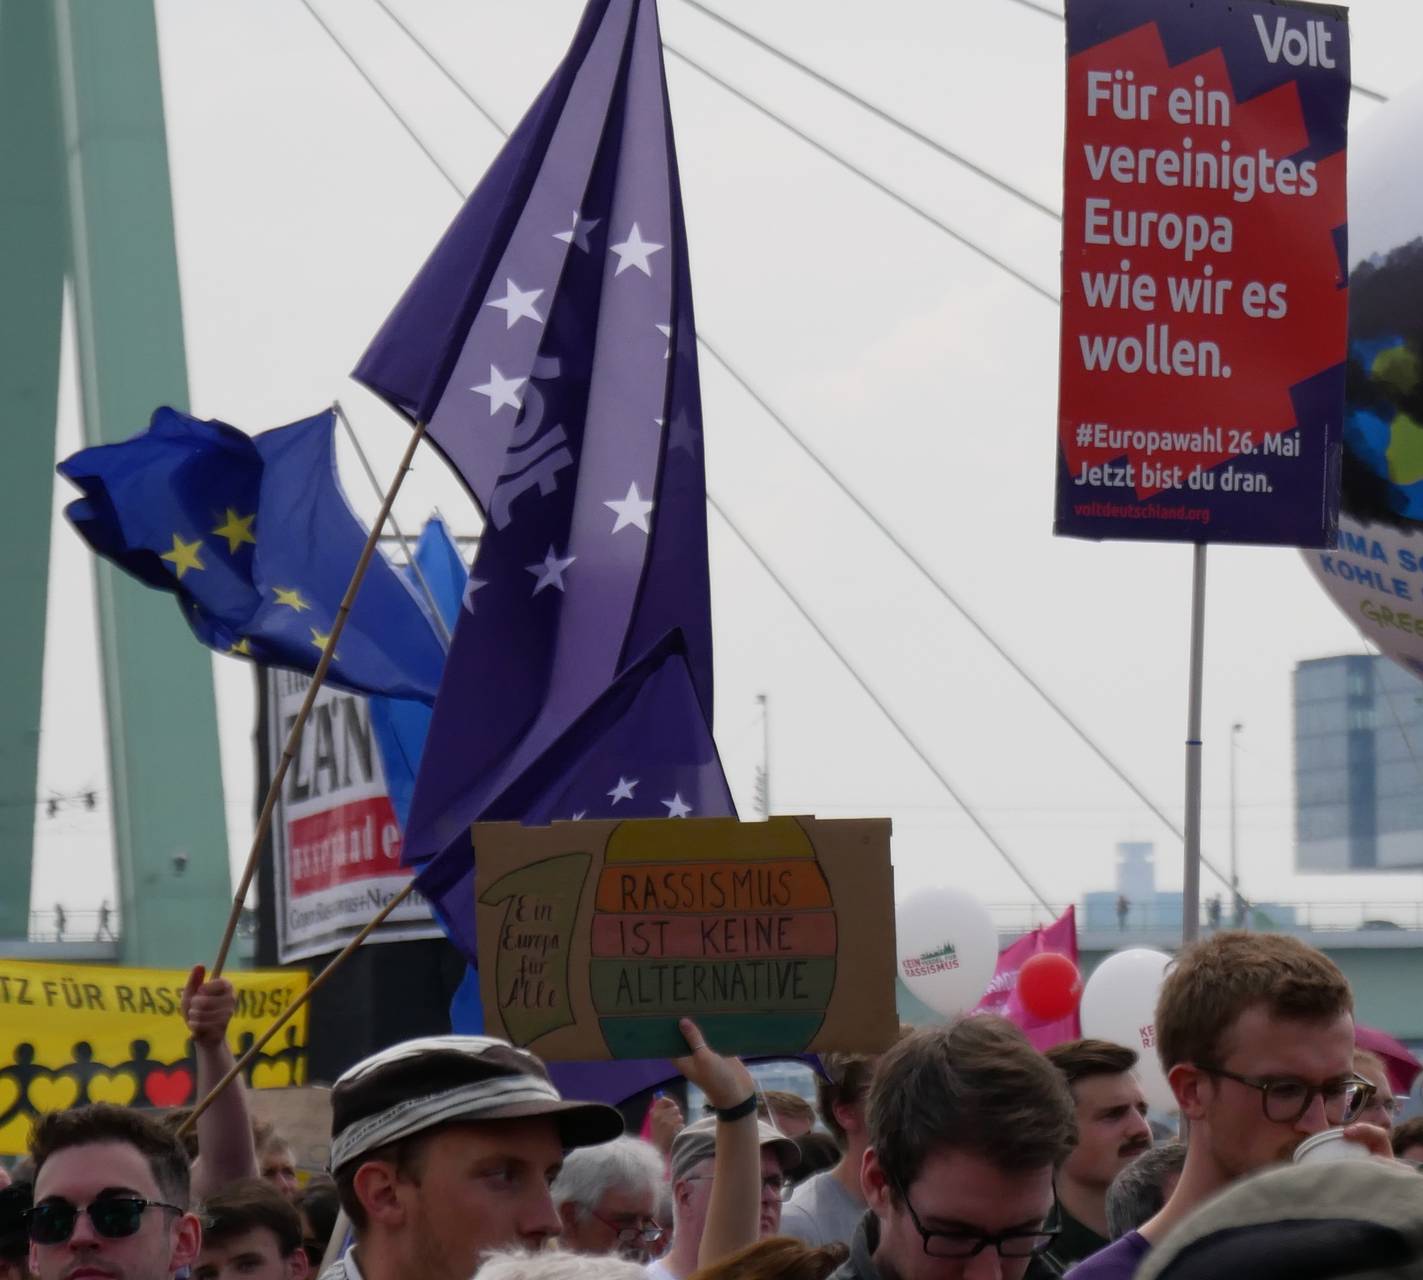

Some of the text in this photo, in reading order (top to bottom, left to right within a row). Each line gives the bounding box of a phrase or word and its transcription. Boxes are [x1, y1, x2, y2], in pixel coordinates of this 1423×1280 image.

[1253, 14, 1336, 69] Volt
[1087, 69, 1230, 127] Für ein
[1083, 136, 1318, 203] vereinigtes
[1084, 197, 1232, 261] Europa
[1081, 259, 1288, 319] wie wir es
[1079, 324, 1231, 378] wollen.
[1076, 423, 1300, 457] #Europawahl 26. Mai
[1074, 461, 1273, 493] Jetzt bist du dran.
[1074, 502, 1211, 524] voltdeutschland.org
[1319, 553, 1412, 600] KOHLE
[621, 869, 794, 910] RASSISMUS
[502, 924, 560, 957] Europa
[619, 916, 794, 956] IST KEINE
[615, 960, 808, 1005] ALTERNATIVE
[904, 959, 960, 977] RASSISMUS
[42, 977, 106, 1012] FÜR
[504, 976, 559, 1009] Alle
